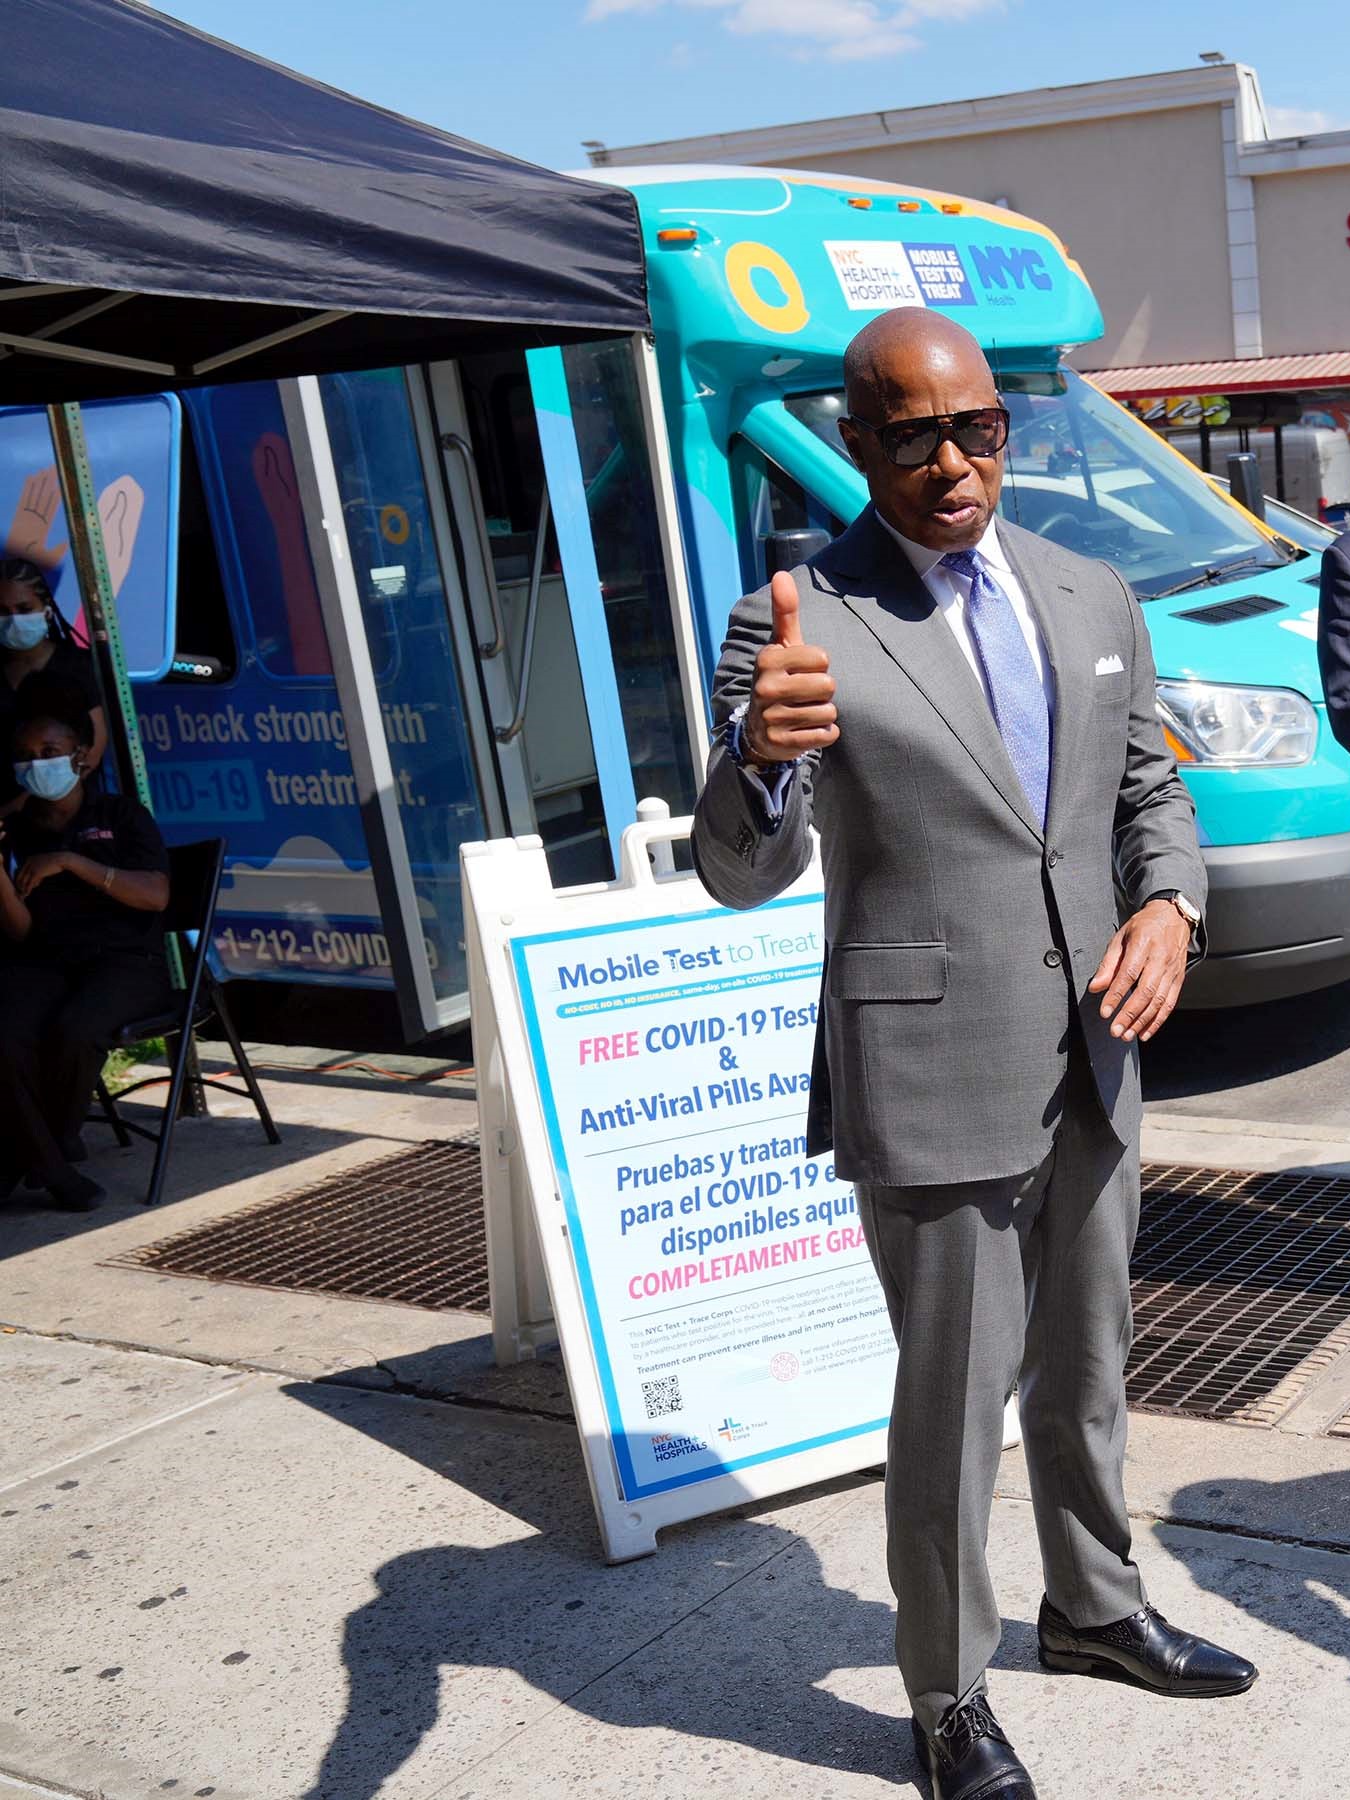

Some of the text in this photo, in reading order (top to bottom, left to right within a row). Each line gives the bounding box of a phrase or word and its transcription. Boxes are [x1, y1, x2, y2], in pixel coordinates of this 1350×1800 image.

[833, 250, 863, 264] NYC
[909, 249, 959, 265] MOBILE
[968, 245, 1053, 291] NYC
[843, 267, 891, 282] HEALTH
[915, 266, 965, 283] TEST TO
[849, 284, 916, 300] HOSPITALS
[923, 283, 962, 299] TREAT
[174, 704, 251, 743] back
[382, 703, 427, 743] ith
[266, 768, 426, 806] treatmt.
[223, 927, 438, 970] 1-212-COVID9
[559, 930, 820, 990] Mobile Test to Treat
[746, 971, 783, 984] COVID-19
[783, 966, 819, 978] treatment
[580, 1031, 639, 1065] FREE
[646, 1009, 766, 1053] COVID-19
[719, 1046, 739, 1071] &
[581, 1086, 703, 1134] Anti-Viral
[708, 1077, 763, 1109] Pills
[617, 1154, 715, 1191] Pruebas
[720, 1151, 734, 1177] y
[621, 1200, 673, 1235] para
[680, 1186, 700, 1214] el
[707, 1163, 818, 1208] COVID-19
[661, 1206, 800, 1255] disponibles
[628, 1235, 823, 1299] COMPLETAMENTE
[645, 1325, 663, 1335] NYC
[664, 1320, 680, 1330] Test
[688, 1313, 709, 1324] Trace
[710, 1307, 733, 1320] Corps
[820, 1284, 834, 1292] unit
[775, 1303, 789, 1312] The
[826, 1302, 842, 1311] cost
[637, 1356, 680, 1374] Treatment
[681, 1355, 696, 1363] can
[697, 1345, 731, 1360] prevent
[732, 1338, 760, 1350] severe
[760, 1330, 785, 1343] illness
[786, 1325, 802, 1337] and
[803, 1323, 812, 1332] in
[813, 1319, 834, 1332] many
[836, 1313, 857, 1324] cases
[651, 1432, 672, 1445] NYC
[653, 1437, 691, 1454] HEALTH
[655, 1441, 708, 1463] HOSPITALS
